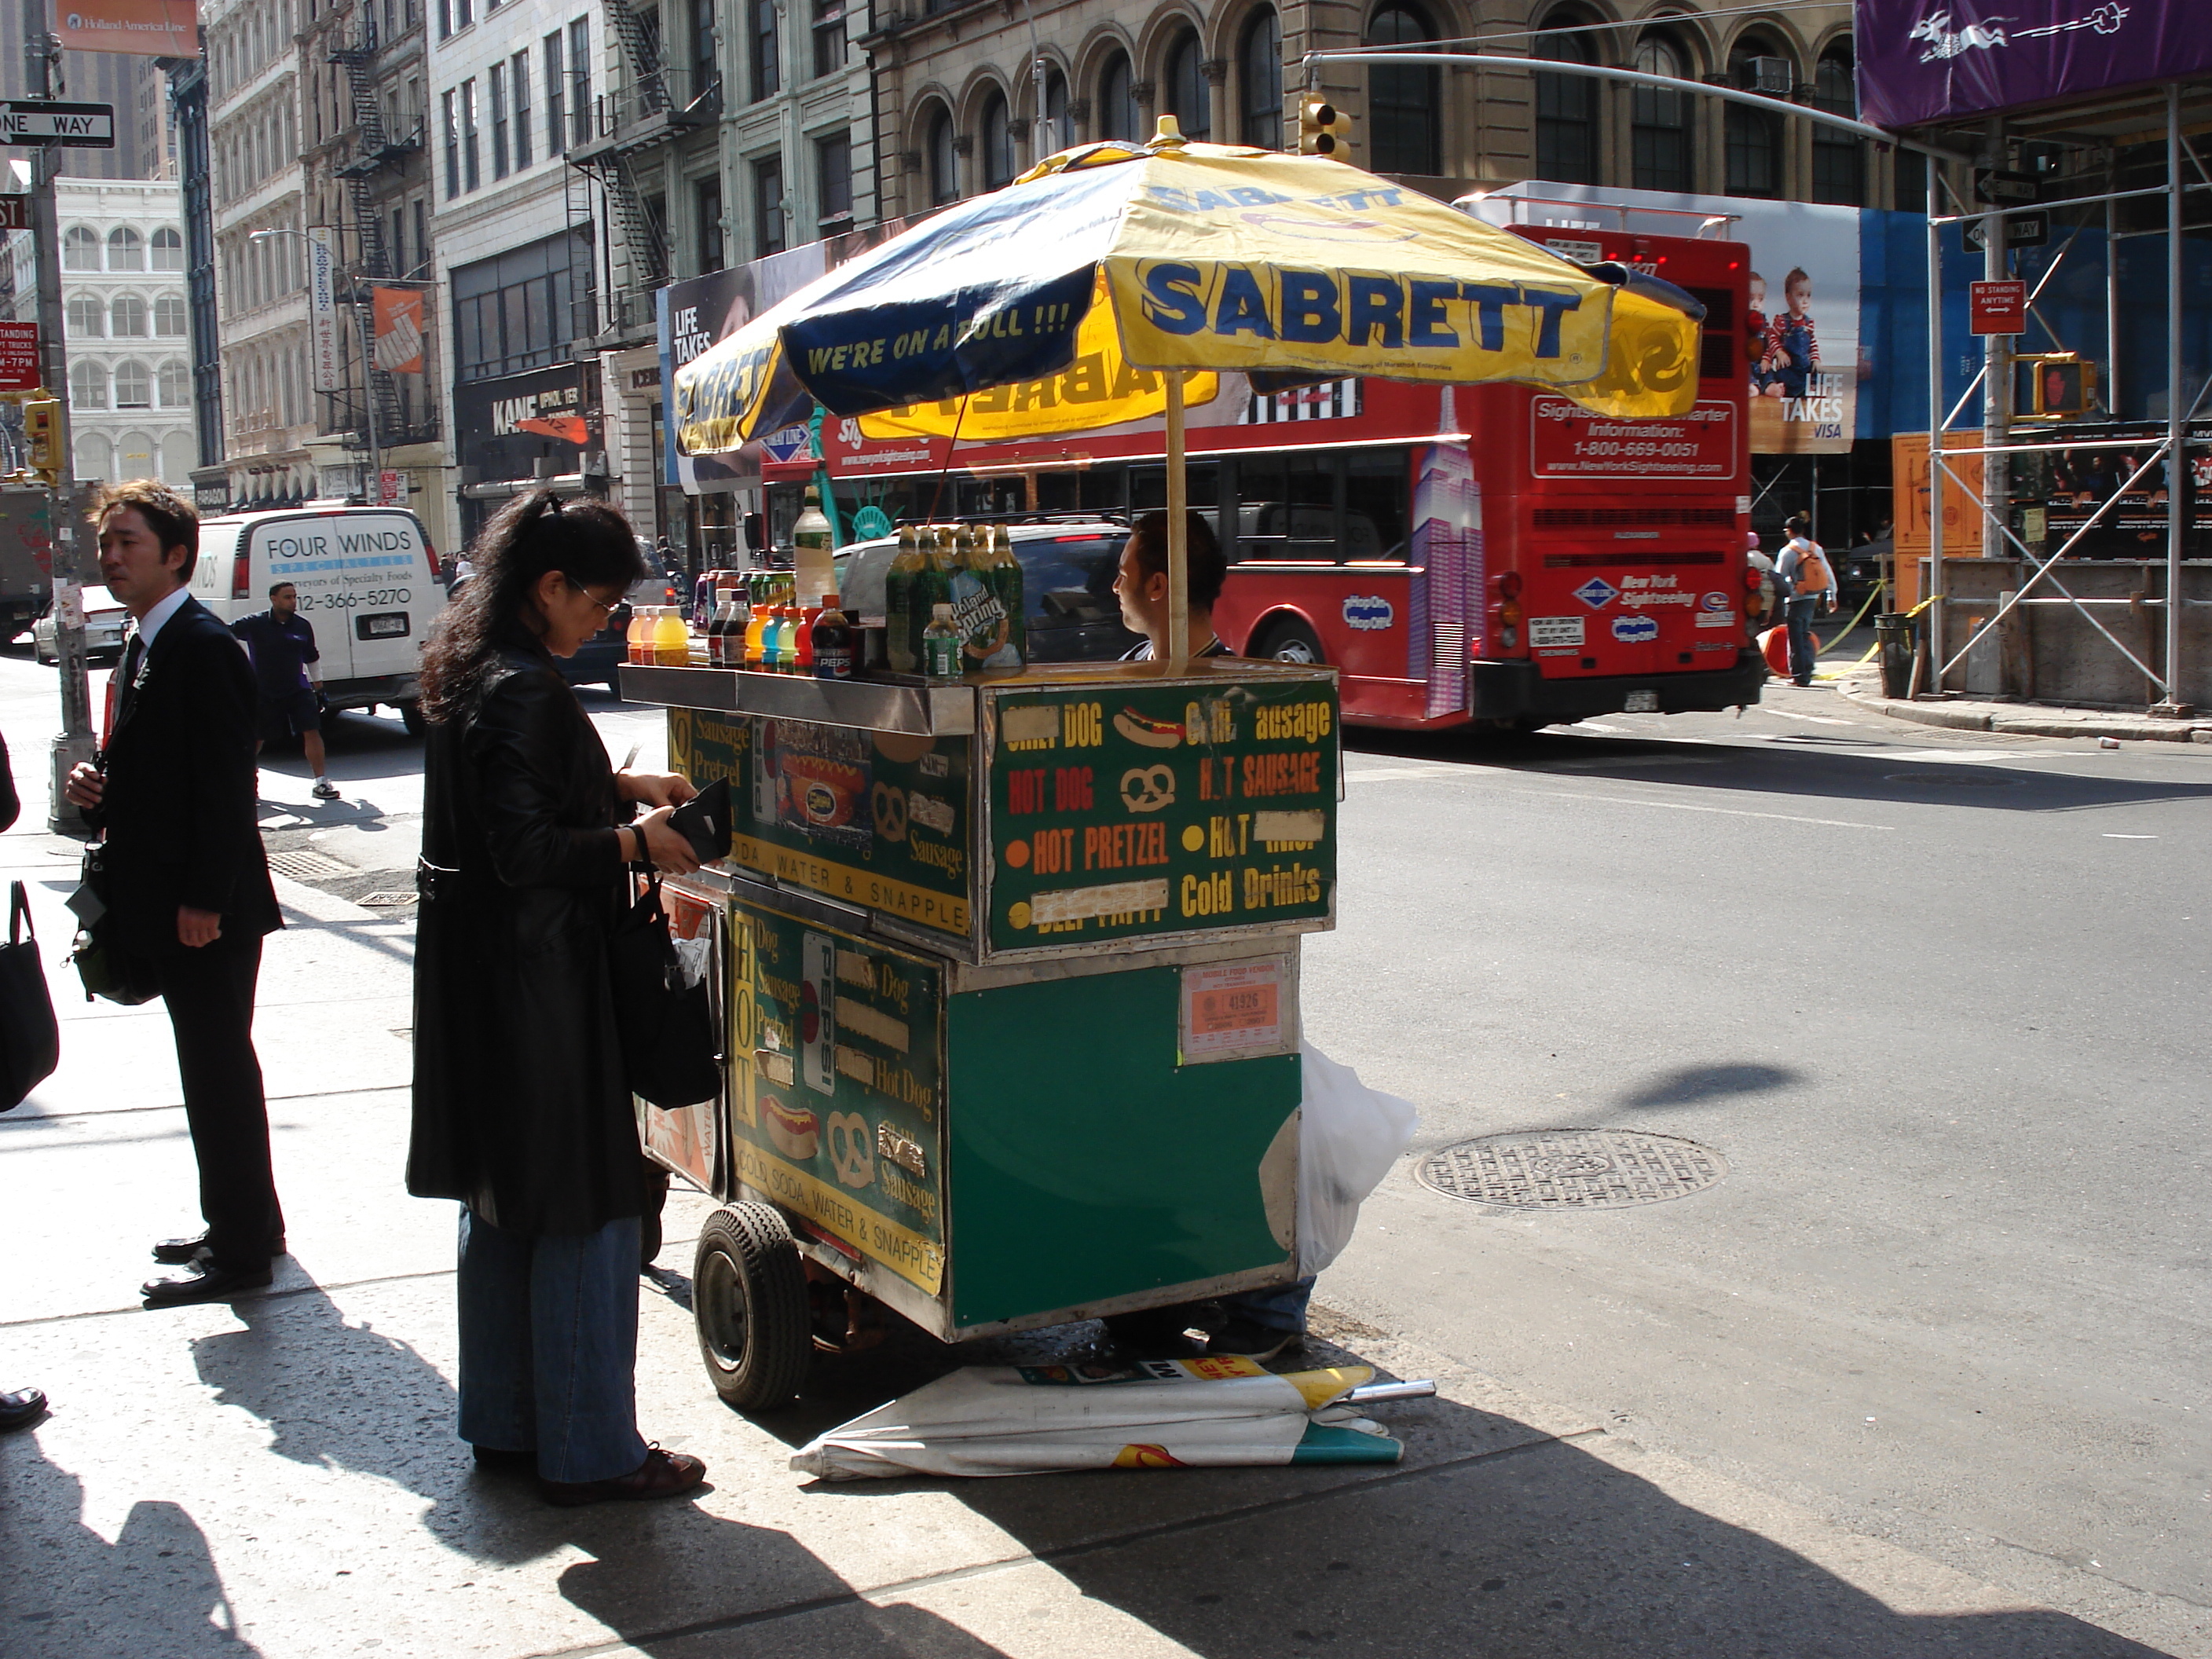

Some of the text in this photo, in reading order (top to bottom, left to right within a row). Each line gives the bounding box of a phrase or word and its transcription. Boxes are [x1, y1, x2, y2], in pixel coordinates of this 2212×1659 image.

[84, 19, 186, 32] Holland America Line
[53, 116, 94, 134] WAY
[1983, 180, 2001, 194] ONE
[1972, 222, 2038, 241] ON WAY
[1979, 296, 2016, 305] ANYTIME
[1987, 285, 2020, 295] STANDING
[674, 306, 698, 337] LIFE
[1141, 259, 1582, 359] SABRETT
[0, 330, 35, 339] TANDING
[8, 341, 33, 350] TRUCKS
[808, 339, 886, 375] WE'RE
[893, 329, 928, 360] ON
[933, 324, 950, 346] A
[1034, 303, 1070, 335] !!!
[0, 357, 33, 368] M-7PM
[1417, 361, 1452, 372] Enterprises
[1805, 372, 1844, 397] LIFE
[493, 394, 537, 437] KANE
[1779, 397, 1844, 423] TAKES
[1587, 422, 1686, 438] Information:
[1814, 423, 1842, 438] VISA
[1573, 441, 1700, 457] 1-800-669-0051
[267, 531, 412, 559] FOUR WINDS
[275, 556, 410, 574] SPECIALTIES
[292, 570, 413, 590] rveyors of Specialty Foods
[1620, 574, 1679, 589] New York
[295, 588, 412, 612] 12-366-5270
[1619, 591, 1697, 609] Sightseeing
[820, 658, 851, 668] PEPS
[697, 711, 749, 756] Sausage
[1064, 702, 1103, 749] DOG
[1254, 701, 1331, 745] ausage
[694, 749, 741, 788] Pretzel
[1199, 752, 1321, 801] HT SAUSAGE
[1008, 766, 1094, 815] HOT DOG
[910, 829, 963, 881] Sausage
[1033, 821, 1170, 875] HOT PRETZEL
[731, 839, 964, 928] ODA, WATER & SNAPPLE
[1181, 862, 1320, 917] Cold Drinks
[756, 917, 779, 964] Dog
[1202, 964, 1276, 979] MOBILE FOOD VENDOR
[757, 962, 800, 1015] Sausage
[881, 963, 910, 1015] Dog
[1229, 992, 1259, 1010] 41926
[735, 921, 753, 1117] HOT
[821, 944, 833, 1086] PEPSI
[876, 1056, 932, 1122] Hot Dog
[881, 1160, 936, 1225] Sausage
[738, 1149, 936, 1282] COLD SODA, WATER & SNAPPLE
